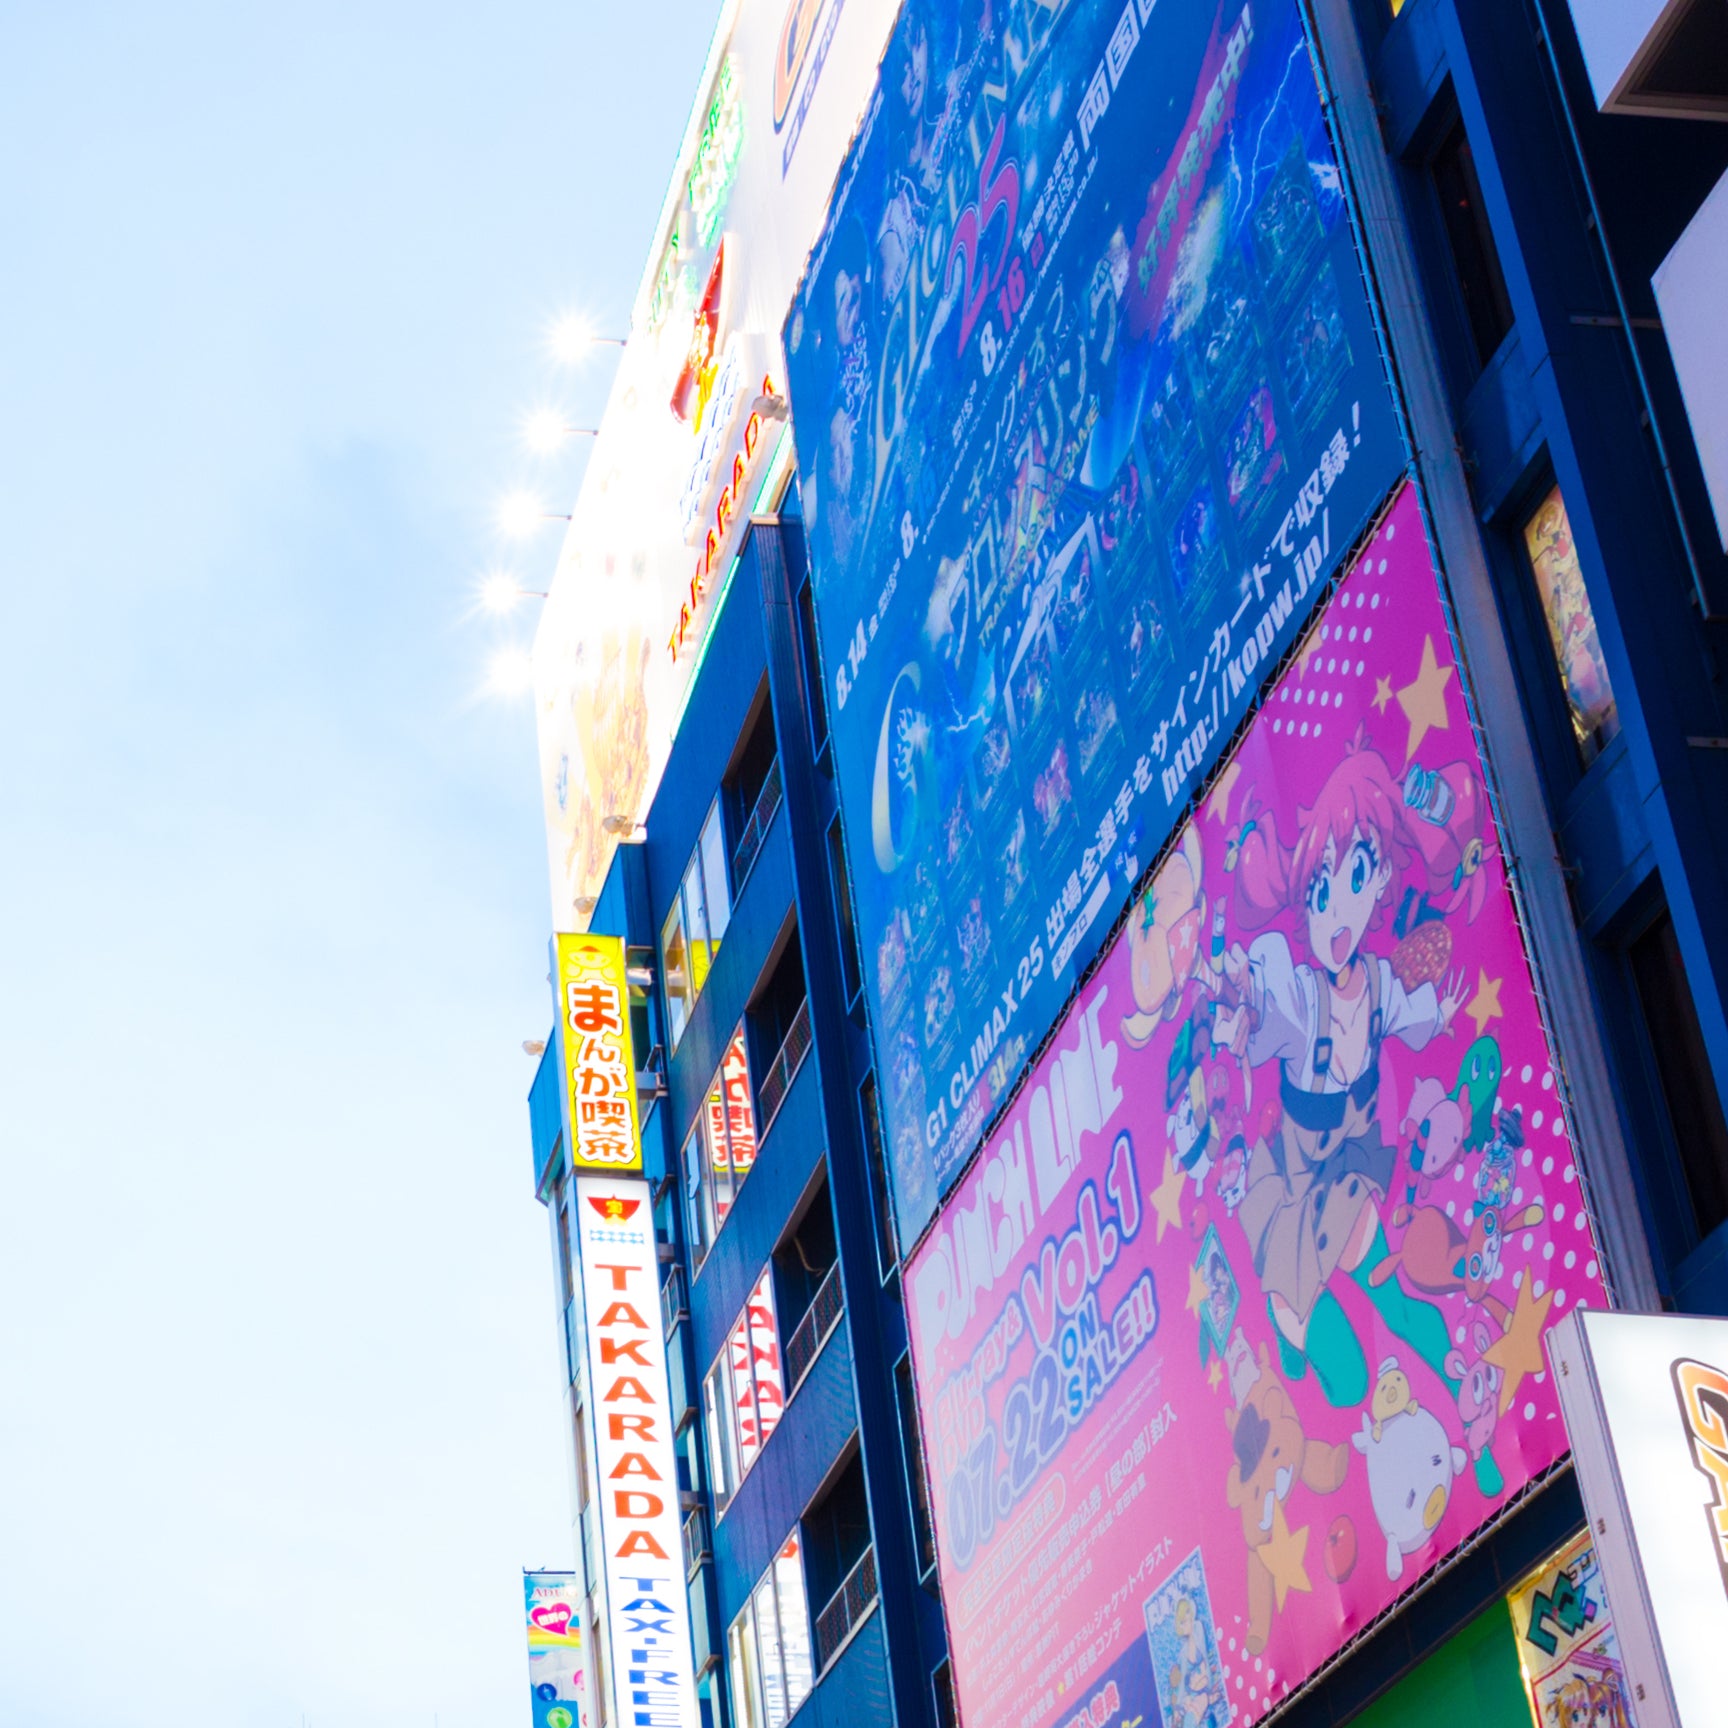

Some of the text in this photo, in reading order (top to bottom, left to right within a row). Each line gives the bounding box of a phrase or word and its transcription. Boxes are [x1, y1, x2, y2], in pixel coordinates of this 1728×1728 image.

[1158, 510, 1332, 810] http://kopw.jp/
[570, 981, 636, 1164] まんが喫茶
[924, 1104, 952, 1154] G1
[948, 984, 1020, 1110] CLIMAX
[1016, 948, 1048, 996] 25
[913, 1146, 1037, 1352] PUNCH
[1028, 983, 1125, 1216] LINE
[1016, 1128, 1143, 1335] Vol.1
[593, 1262, 670, 1562] TAKARADA
[1058, 1296, 1098, 1370] ON
[1062, 1266, 1160, 1428] SALE!!
[940, 1318, 1066, 1573] 07.22
